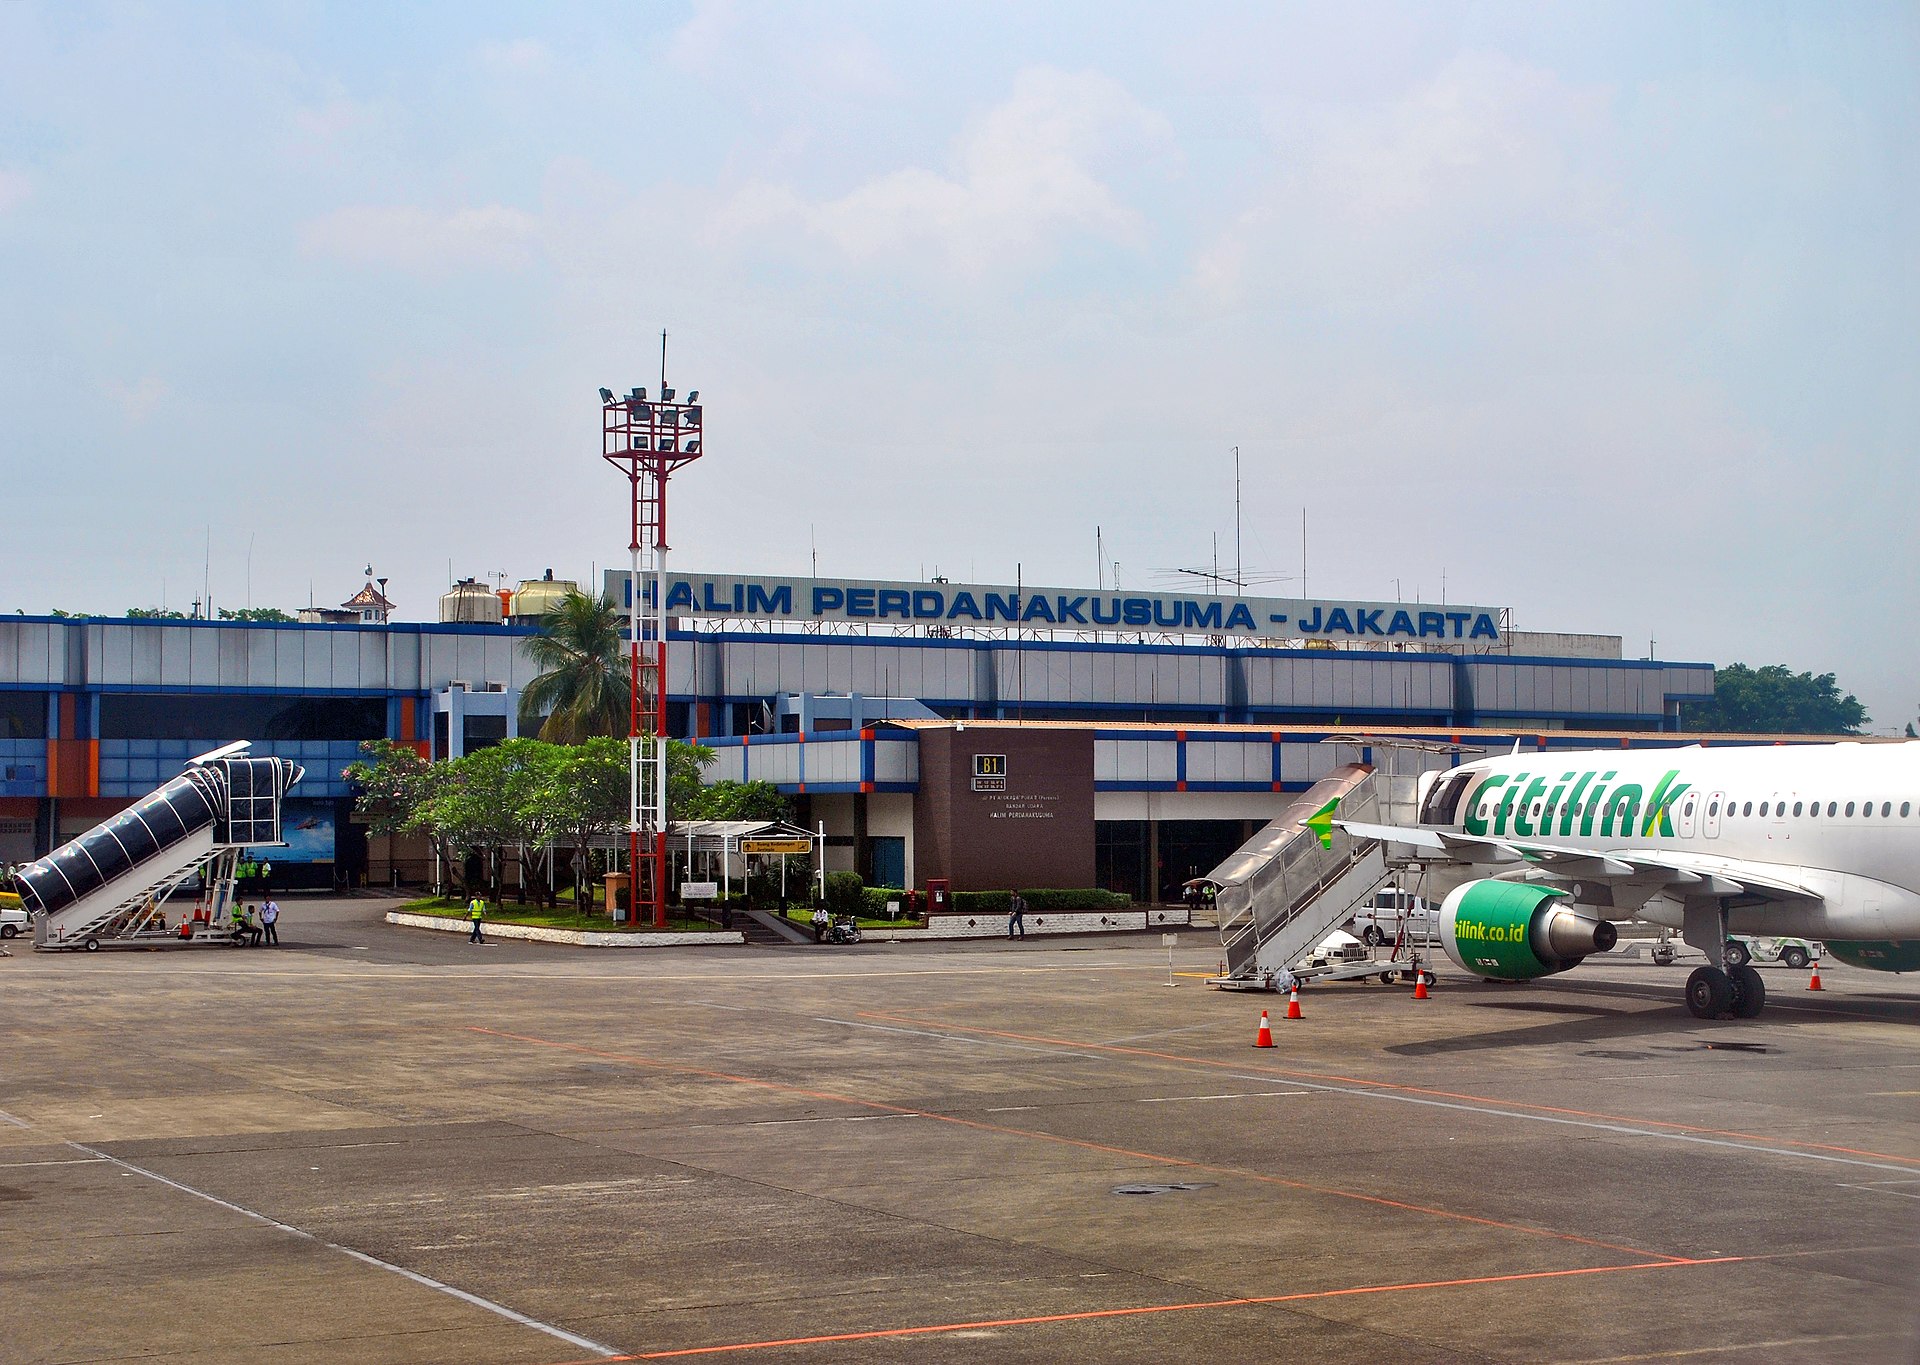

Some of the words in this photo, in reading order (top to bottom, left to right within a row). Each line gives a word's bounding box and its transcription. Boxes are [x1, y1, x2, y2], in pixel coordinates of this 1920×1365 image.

[624, 578, 792, 615] HALIM
[812, 586, 1257, 630] PERDANAKUSUMA
[1269, 614, 1287, 623] -
[1298, 606, 1498, 640] JAKARTA
[983, 757, 997, 773] B1
[1464, 769, 1692, 838] Citilink
